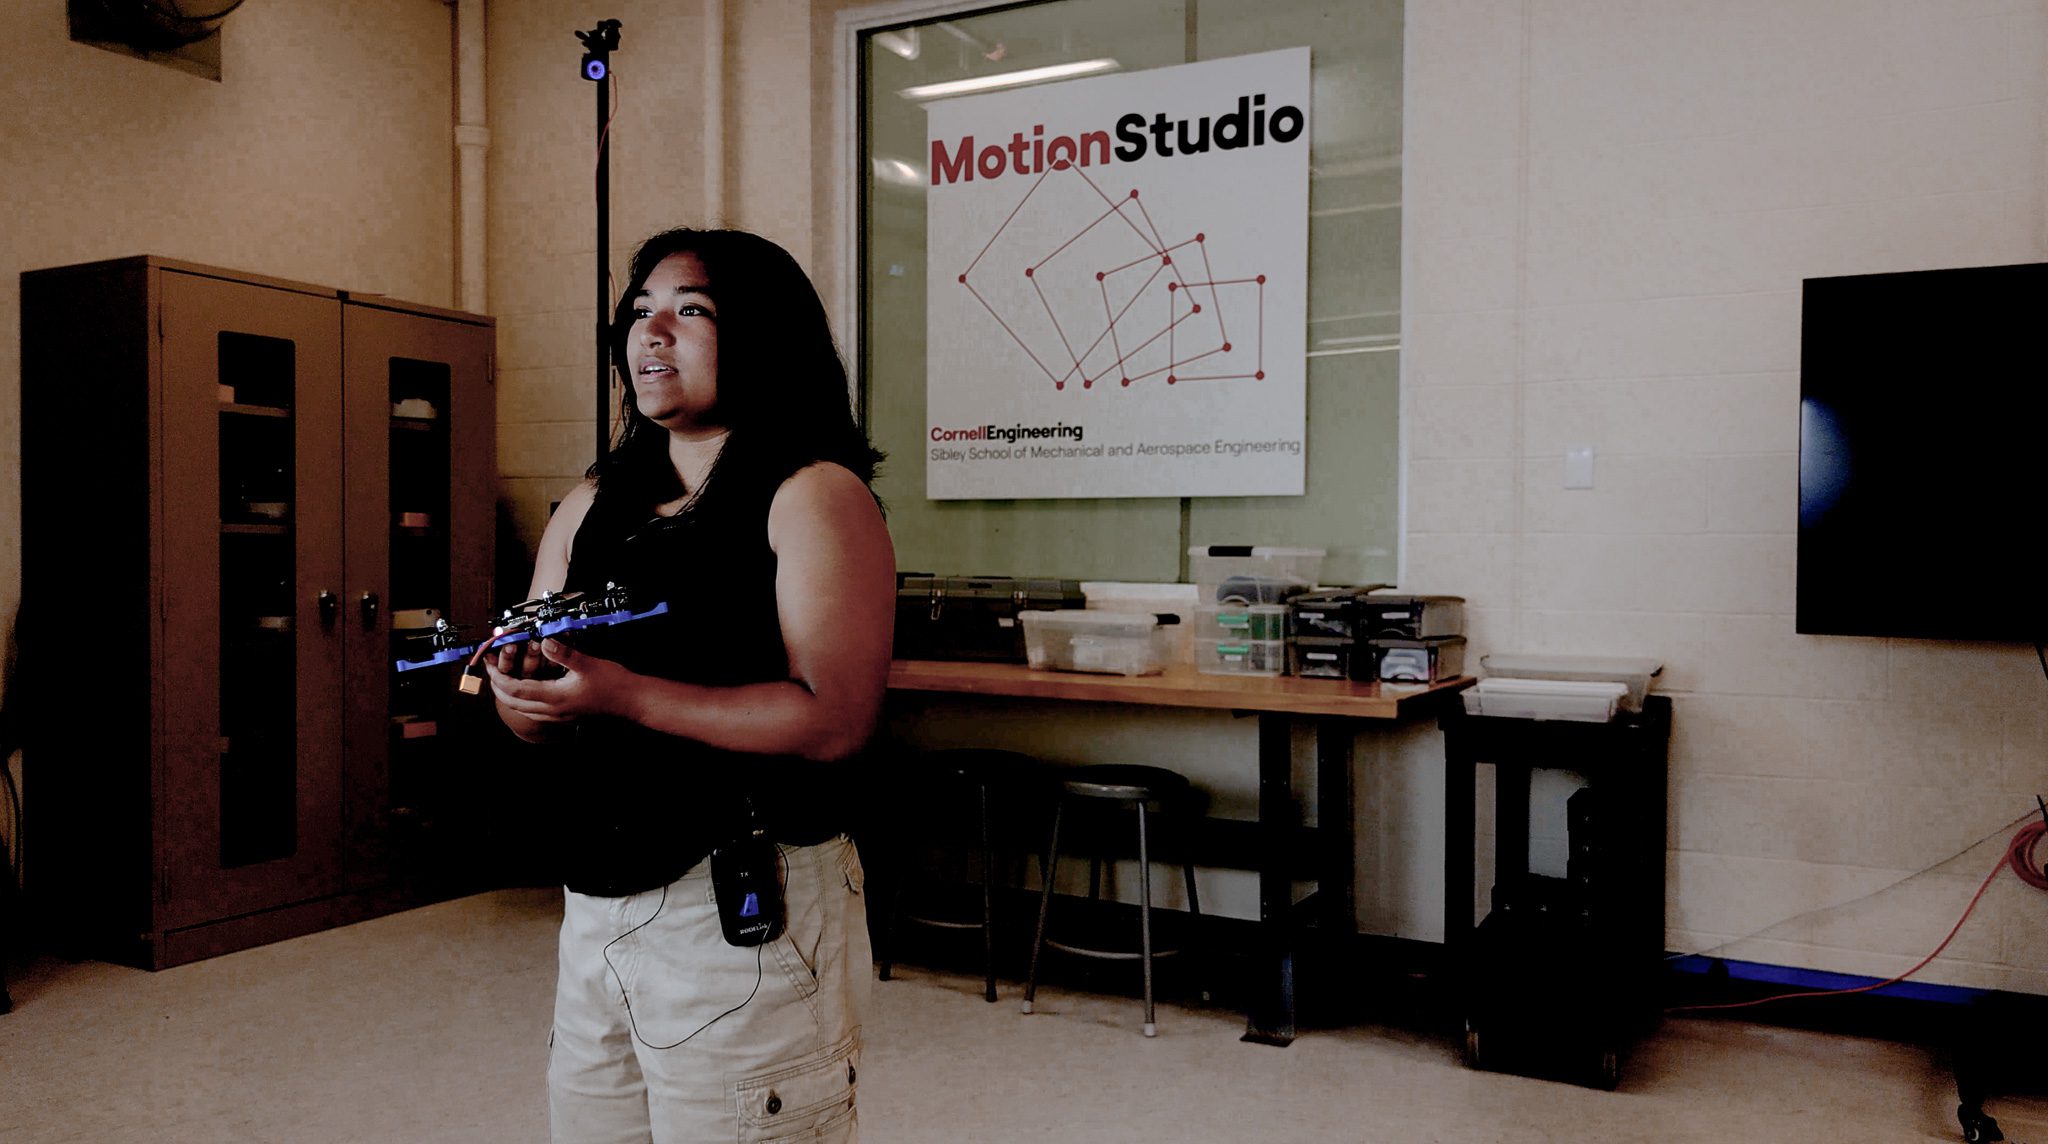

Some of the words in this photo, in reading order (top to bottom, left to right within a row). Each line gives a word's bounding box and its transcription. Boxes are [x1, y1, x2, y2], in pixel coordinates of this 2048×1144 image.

[931, 93, 1304, 186] MotionStudio
[931, 422, 1083, 443] CornellEngineering
[931, 448, 966, 462] Sibley
[969, 446, 1011, 460] School
[1014, 446, 1028, 459] of
[1031, 444, 1104, 458] Mechanical
[1108, 443, 1133, 457] and
[1136, 442, 1210, 457] Aerospace
[1214, 438, 1300, 457] Engineering
